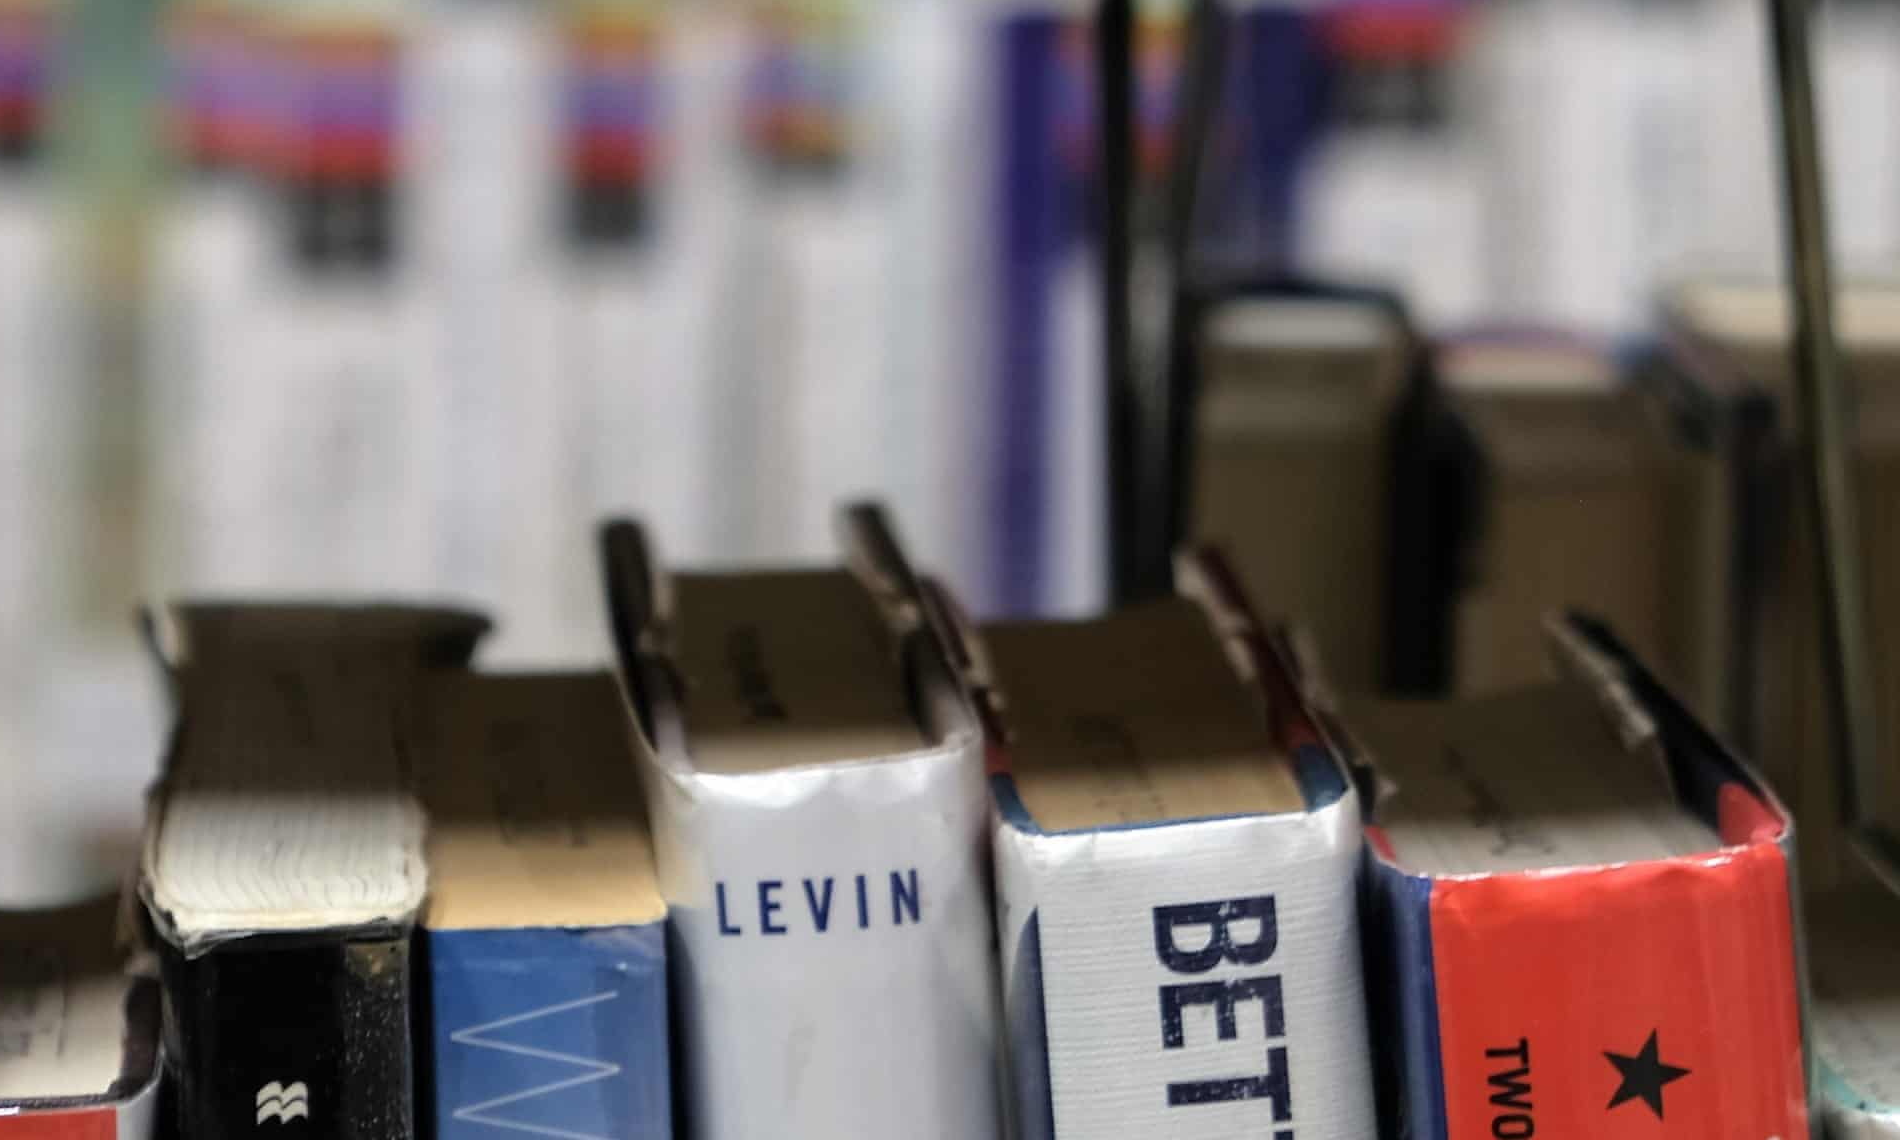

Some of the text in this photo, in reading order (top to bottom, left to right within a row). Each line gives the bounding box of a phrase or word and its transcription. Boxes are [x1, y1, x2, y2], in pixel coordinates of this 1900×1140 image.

[716, 869, 920, 935] LEVIN
[1153, 895, 1294, 1140] BET
[1485, 1037, 1534, 1140] TWO
